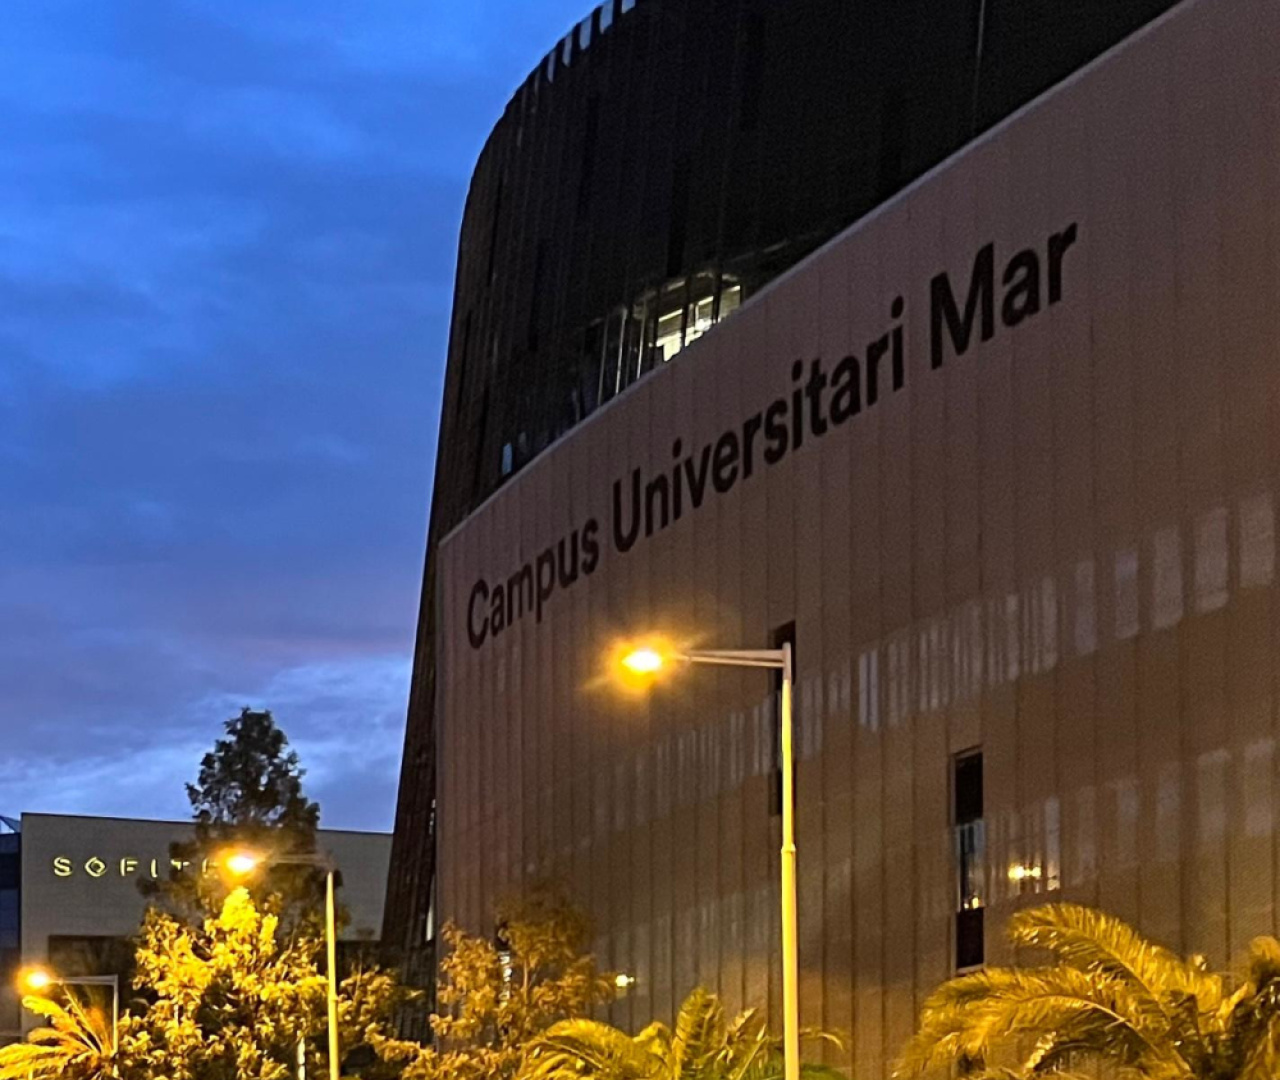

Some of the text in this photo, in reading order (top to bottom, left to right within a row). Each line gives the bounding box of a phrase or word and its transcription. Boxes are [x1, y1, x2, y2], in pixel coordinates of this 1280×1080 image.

[466, 222, 1078, 650] Campus Universitari Mar
